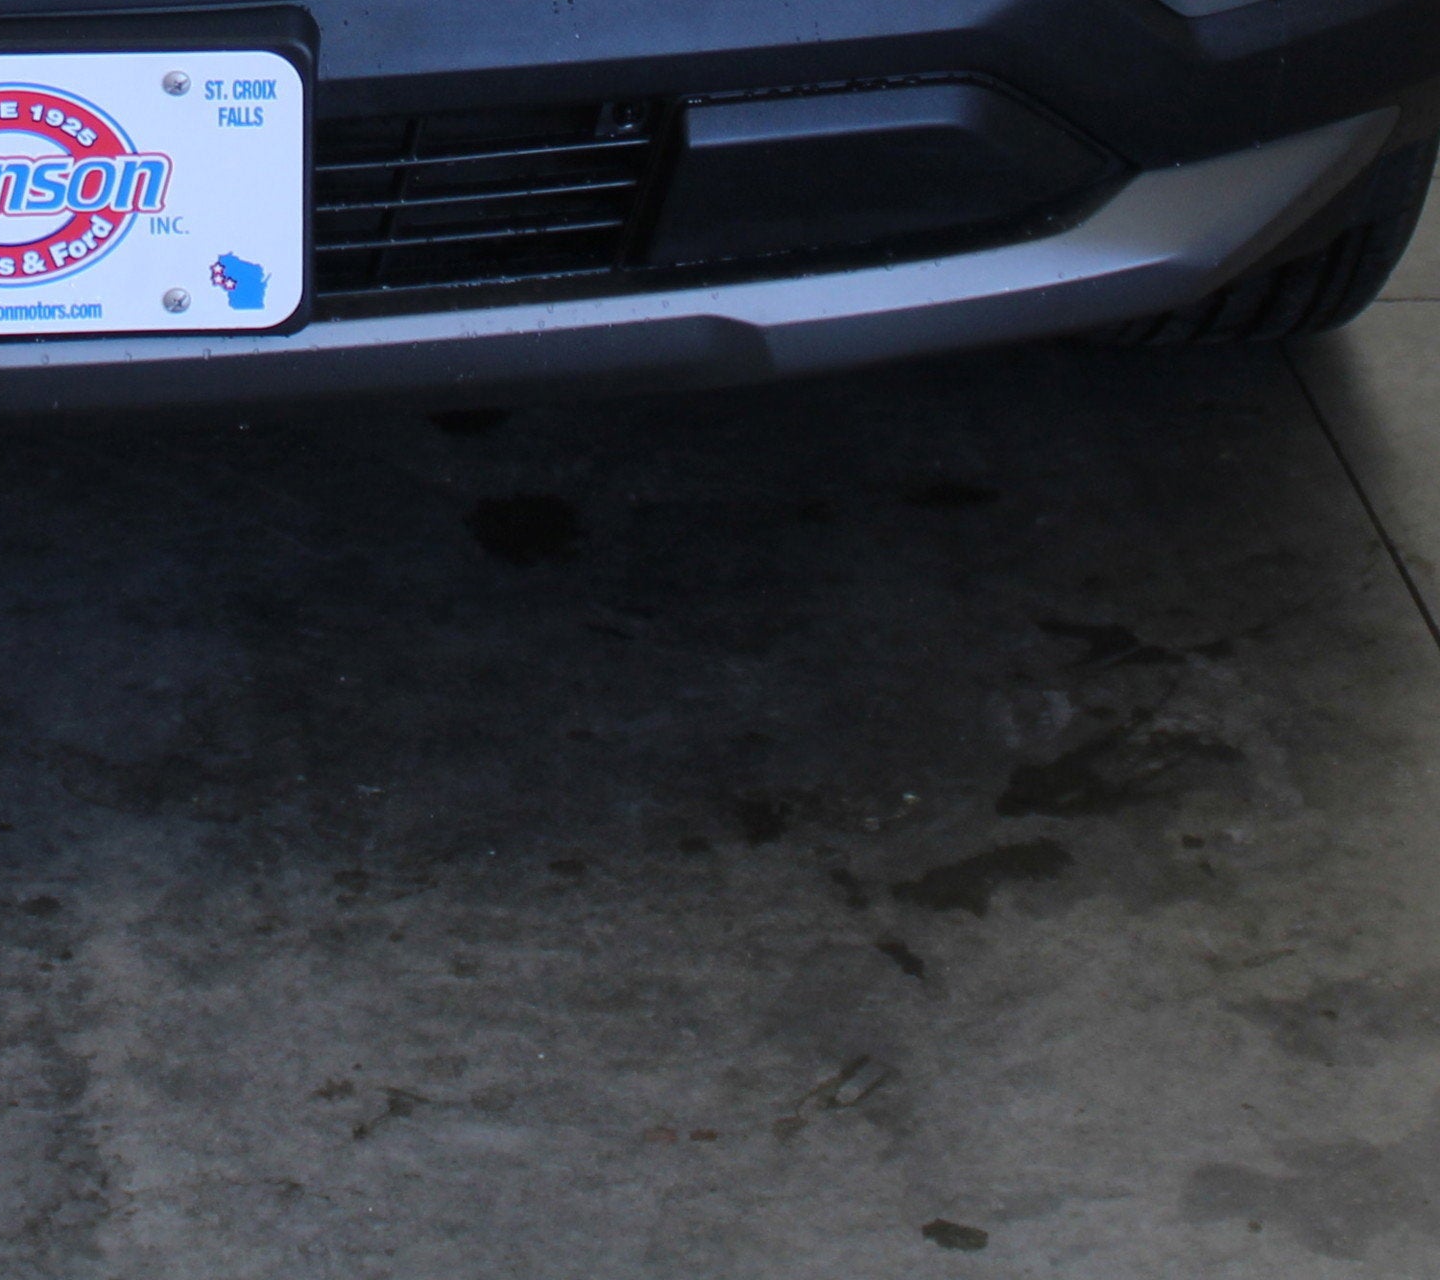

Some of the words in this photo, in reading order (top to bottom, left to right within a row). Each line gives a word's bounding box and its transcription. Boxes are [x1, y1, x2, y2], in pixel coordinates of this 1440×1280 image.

[204, 80, 228, 100] ST.
[232, 79, 277, 100] CROIX
[29, 104, 98, 147] 1925
[218, 106, 264, 127] FALLS
[149, 215, 190, 236] INC.
[21, 250, 47, 275] &
[48, 215, 115, 268] Ford
